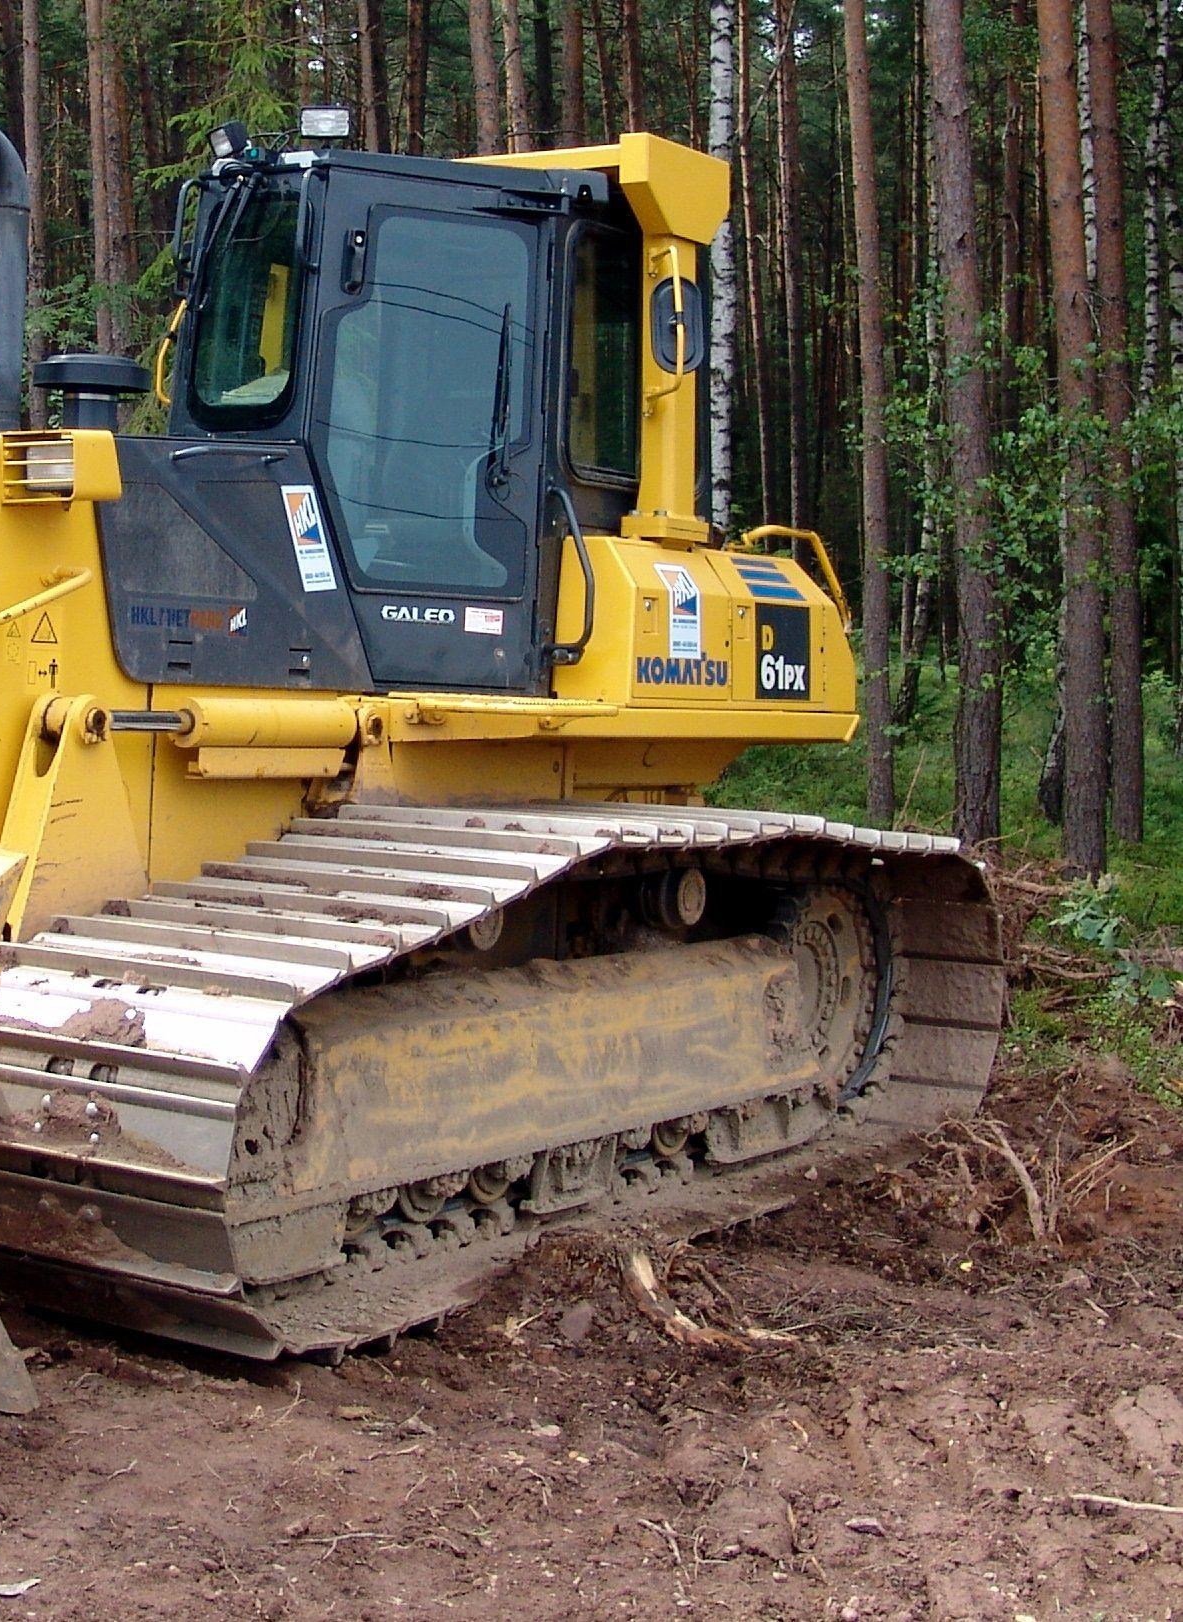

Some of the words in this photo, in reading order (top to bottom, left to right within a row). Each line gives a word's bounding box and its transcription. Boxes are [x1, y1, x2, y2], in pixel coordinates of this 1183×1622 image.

[381, 605, 455, 623] GALEO
[761, 624, 774, 650] D
[636, 653, 728, 687] KOMATSU
[760, 654, 806, 691] 61PX
